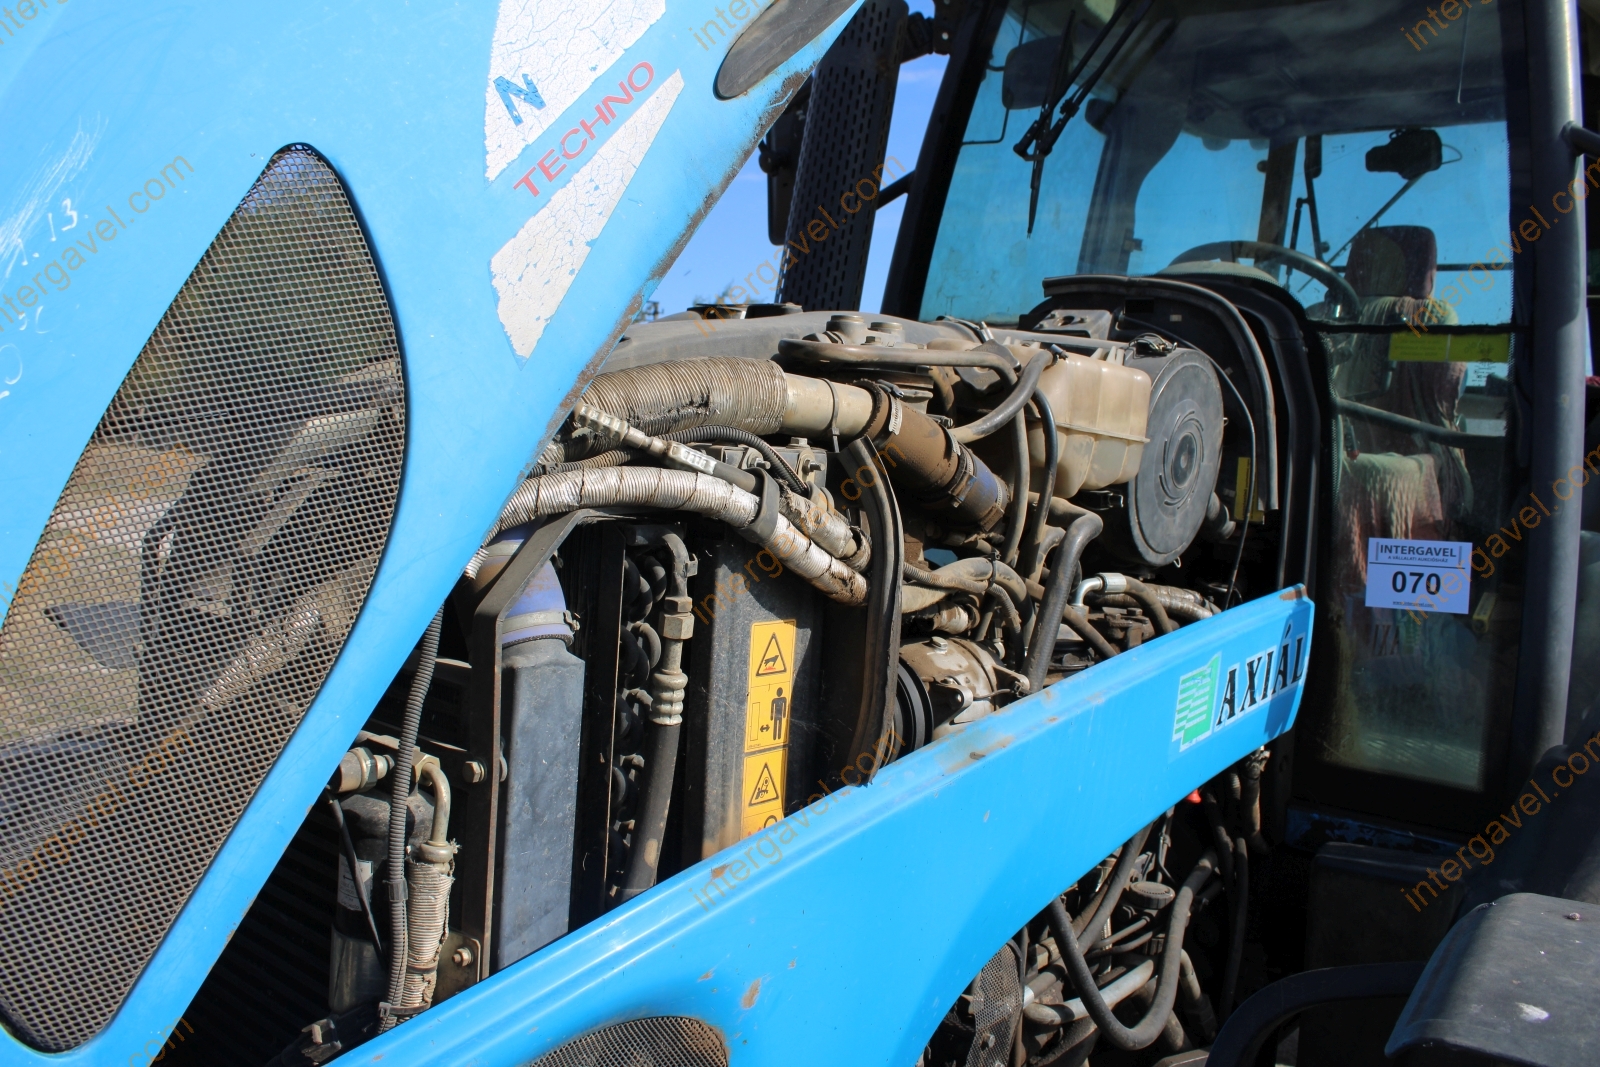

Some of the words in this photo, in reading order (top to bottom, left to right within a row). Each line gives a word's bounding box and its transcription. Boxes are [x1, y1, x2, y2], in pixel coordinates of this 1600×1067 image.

[493, 73, 546, 127] N
[513, 61, 655, 198] TECHNO
[1380, 544, 1457, 558] INTERGAVEL
[1392, 570, 1441, 595] 070
[1215, 624, 1305, 727] AXIÁL
